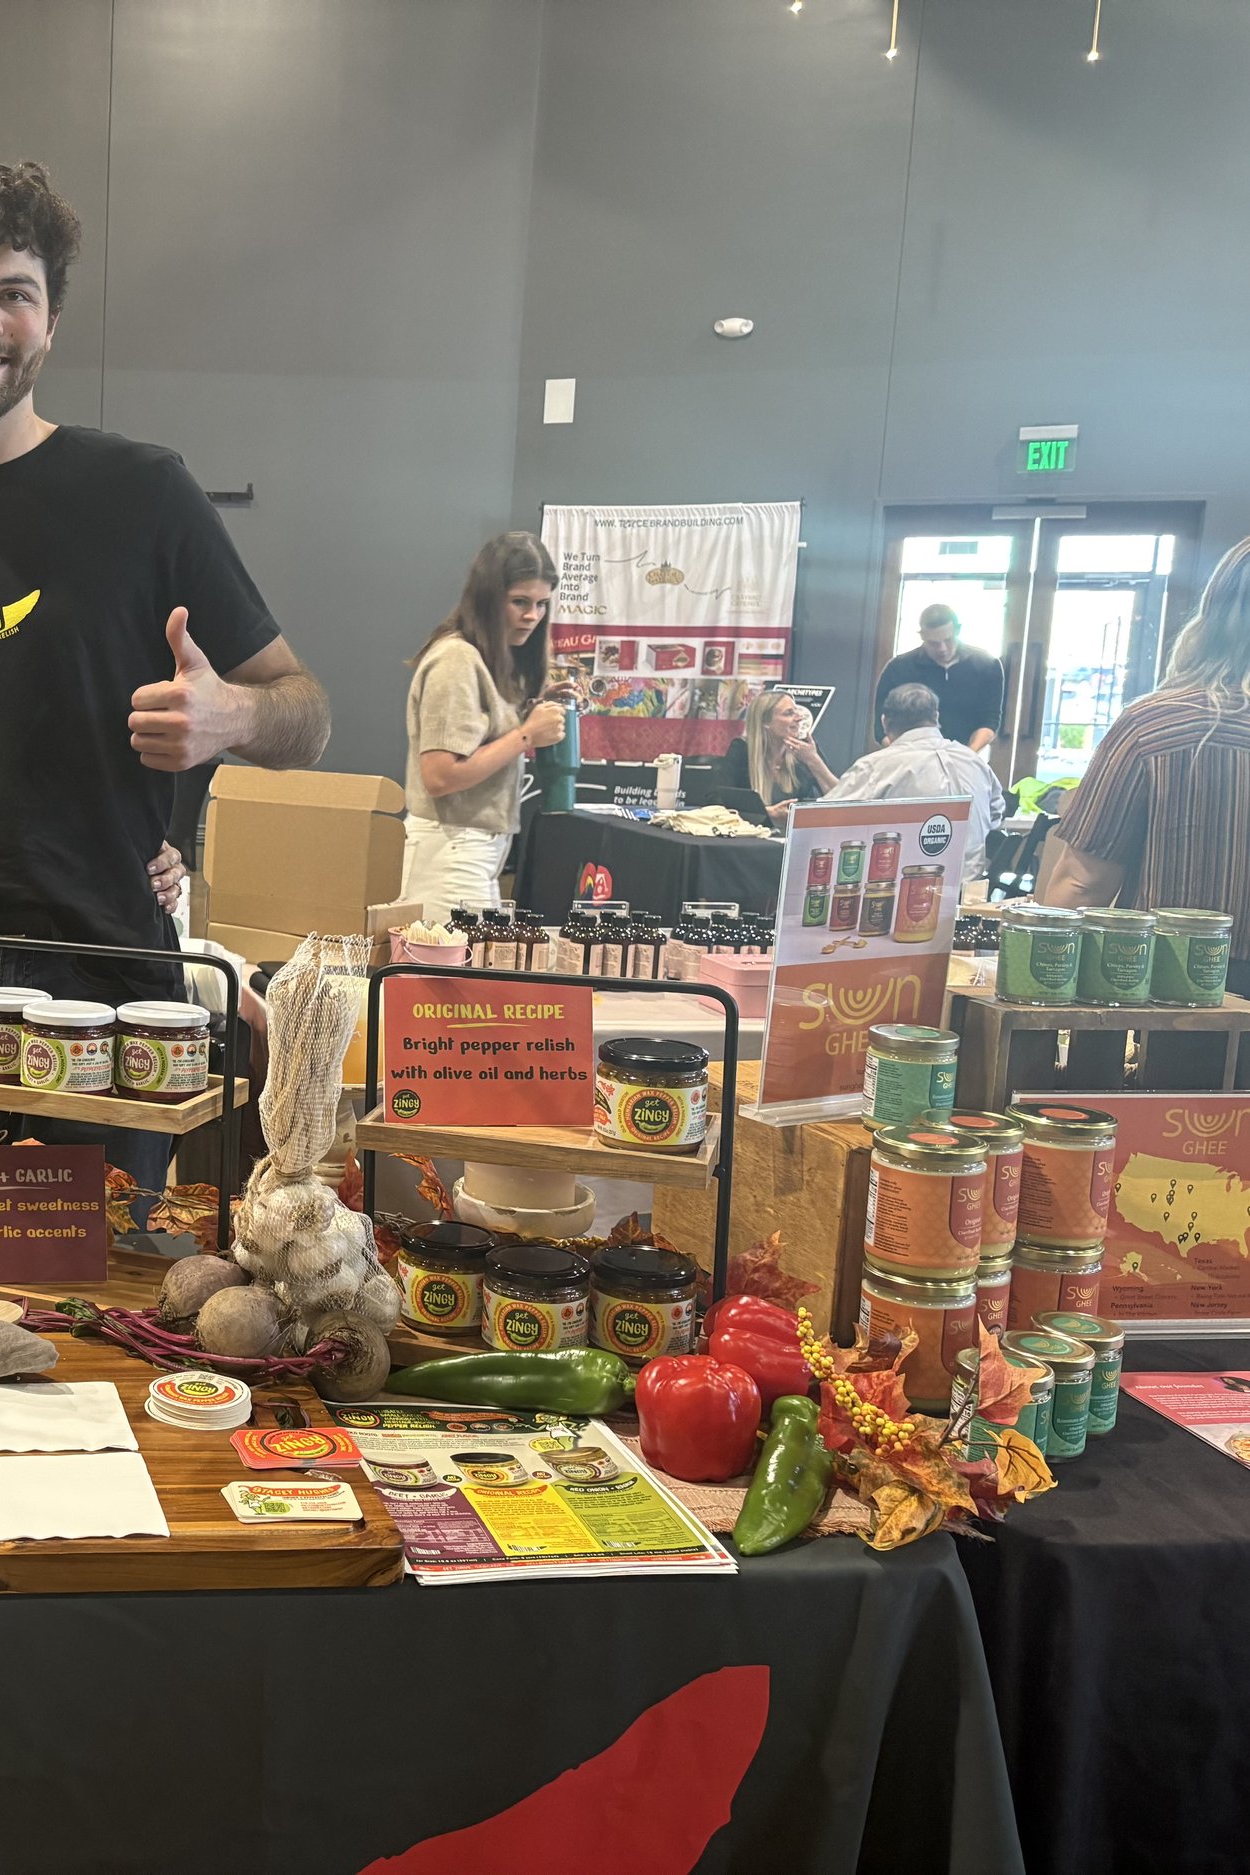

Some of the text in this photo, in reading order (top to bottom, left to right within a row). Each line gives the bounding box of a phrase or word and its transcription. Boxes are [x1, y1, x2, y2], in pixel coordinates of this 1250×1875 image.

[1027, 441, 1068, 470] EXIT
[563, 552, 579, 561] We
[563, 562, 591, 571] Brand
[561, 573, 599, 583] Average
[560, 583, 580, 591] into
[560, 593, 589, 601] Brand
[558, 605, 607, 615] MAGIC
[614, 785, 651, 797] Building
[614, 797, 623, 805] to
[625, 796, 636, 805] be
[927, 825, 945, 834] USDA
[923, 837, 947, 845] ORGANIC
[413, 1004, 565, 1020] ORIGINAL RECIPE
[403, 1036, 575, 1056] Bright pepper relish
[825, 1031, 867, 1056] GHE
[391, 1066, 587, 1082] with olive oil and herbs
[645, 1099, 660, 1108] get
[1182, 1140, 1228, 1155] GHEE
[15, 1169, 73, 1183] GARLIC
[17, 1199, 99, 1212] sweetness
[26, 1225, 87, 1238] accents
[432, 1284, 446, 1292] get
[1112, 1285, 1144, 1293] Wyoming
[1076, 1300, 1093, 1308] GHEE
[514, 1312, 528, 1320] get
[625, 1312, 639, 1320] get
[988, 1311, 1004, 1320] GHEE
[252, 1486, 335, 1495] STACEY HUGHES
